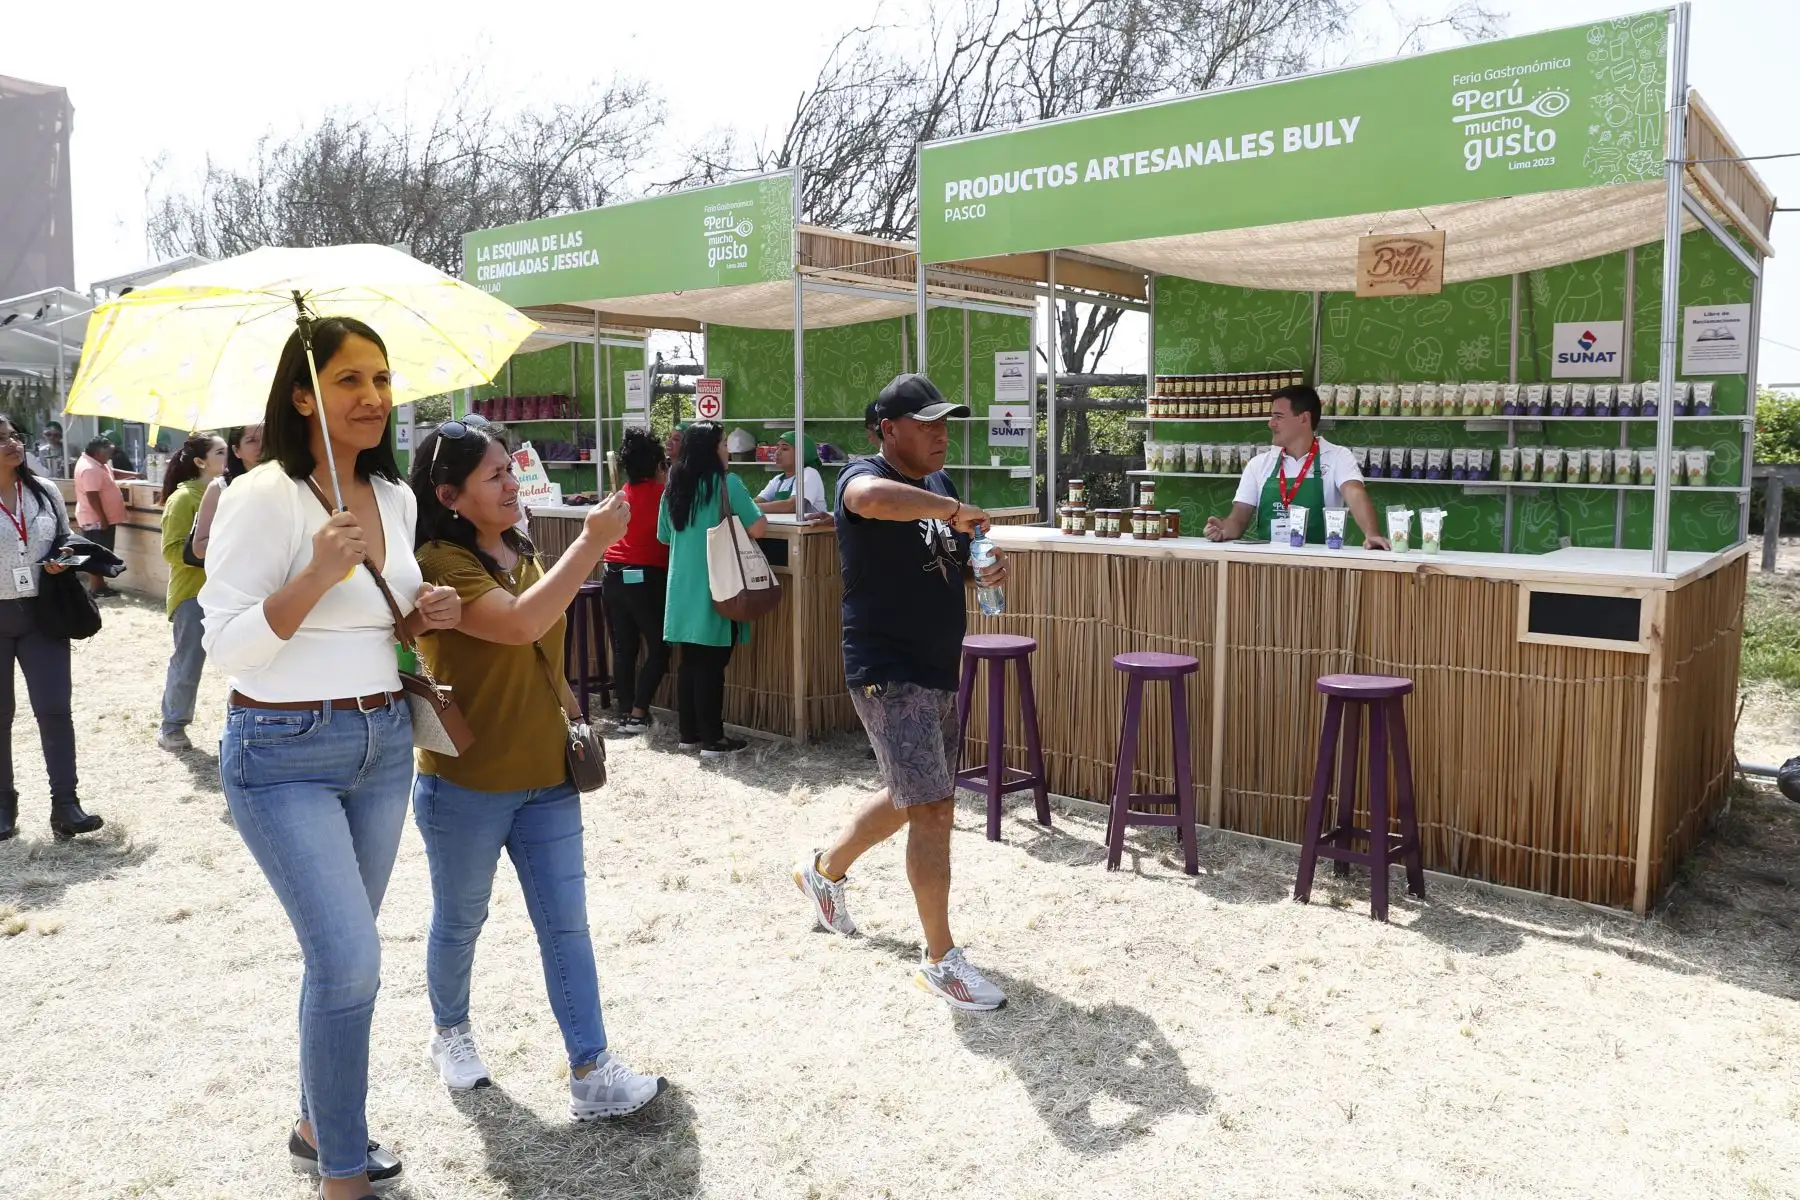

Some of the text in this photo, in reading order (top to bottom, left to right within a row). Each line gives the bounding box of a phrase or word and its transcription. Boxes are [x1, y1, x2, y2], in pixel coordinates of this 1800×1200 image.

[1453, 57, 1571, 86] Feria Gastronómica
[1452, 79, 1523, 112] Perú
[1464, 116, 1523, 136] mucho
[944, 116, 1361, 203] PRODUCTOS ARTESANALES BULY
[1463, 124, 1556, 171] gusto
[1508, 156, 1556, 171] Lima 2023
[703, 210, 734, 230] Perú
[944, 203, 986, 223] PASCO
[477, 230, 583, 262] LA ESQUINA DE LAS
[708, 234, 734, 246] mucho
[477, 249, 600, 281] CREMOLADAS JESSICA
[708, 240, 748, 268] gusto
[1557, 351, 1617, 364] SUNAT
[991, 427, 1026, 437] SUNAT
